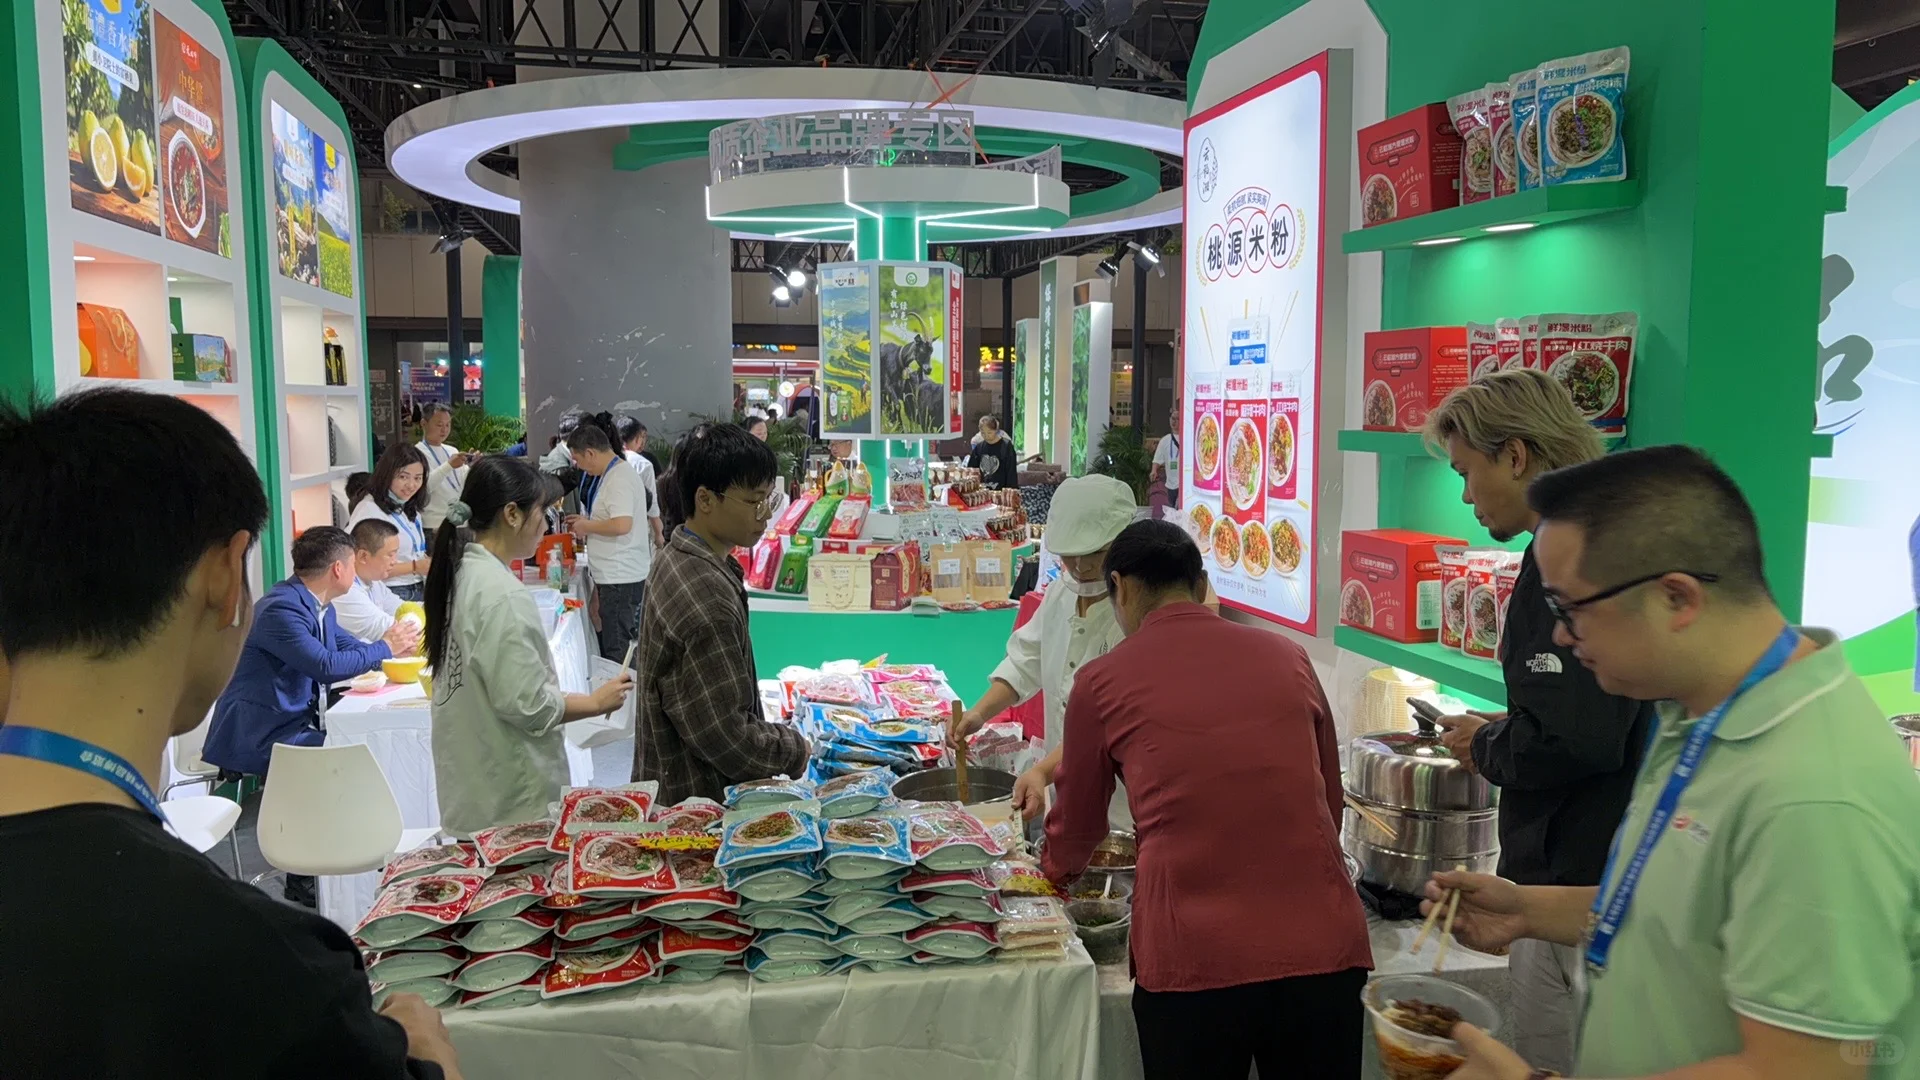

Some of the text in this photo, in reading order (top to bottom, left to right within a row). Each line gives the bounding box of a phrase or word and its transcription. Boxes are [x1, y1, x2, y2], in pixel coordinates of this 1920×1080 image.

[1206, 216, 1290, 272] 桃源米粉
[1526, 659, 1548, 668] NORTH
[1531, 665, 1548, 673] FACE
